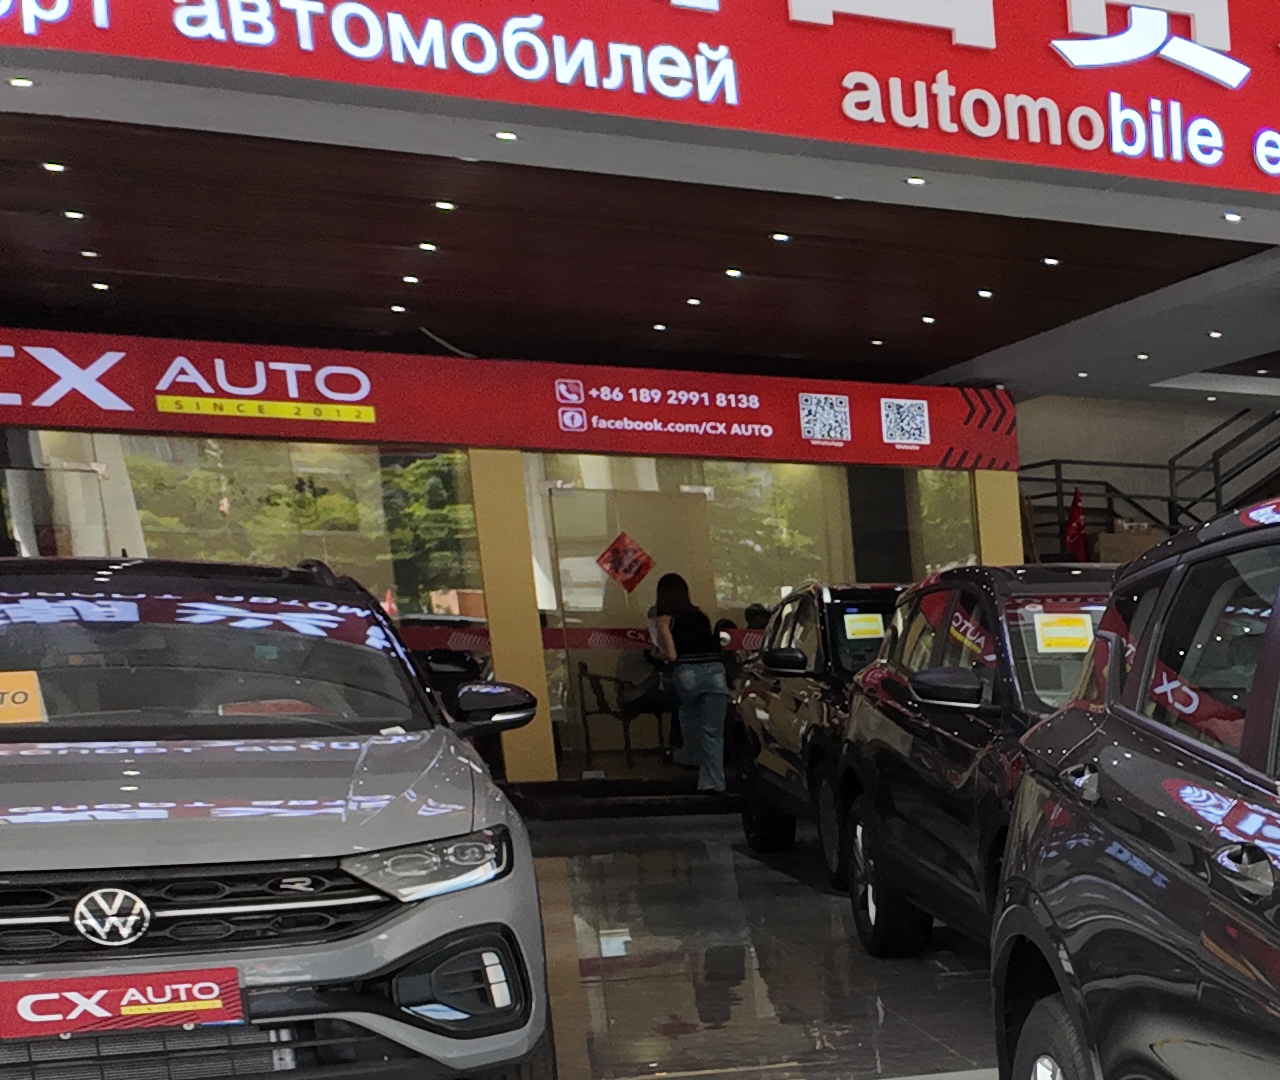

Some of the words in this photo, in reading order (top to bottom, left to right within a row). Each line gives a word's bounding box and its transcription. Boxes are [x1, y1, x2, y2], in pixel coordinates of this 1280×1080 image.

[172, 0, 739, 106] автомобилей
[841, 69, 1226, 167] automobile
[155, 356, 371, 401] AUTO
[588, 386, 624, 402] +86
[628, 387, 662, 403] 189
[666, 390, 710, 406] 2991
[715, 392, 761, 409] 8138
[174, 400, 266, 415] SINCE
[294, 406, 363, 419] 2012
[591, 415, 727, 435] facebook.com/CX
[730, 423, 773, 438] AUTO
[16, 989, 113, 1022] CX
[120, 982, 221, 1005] AUTO
